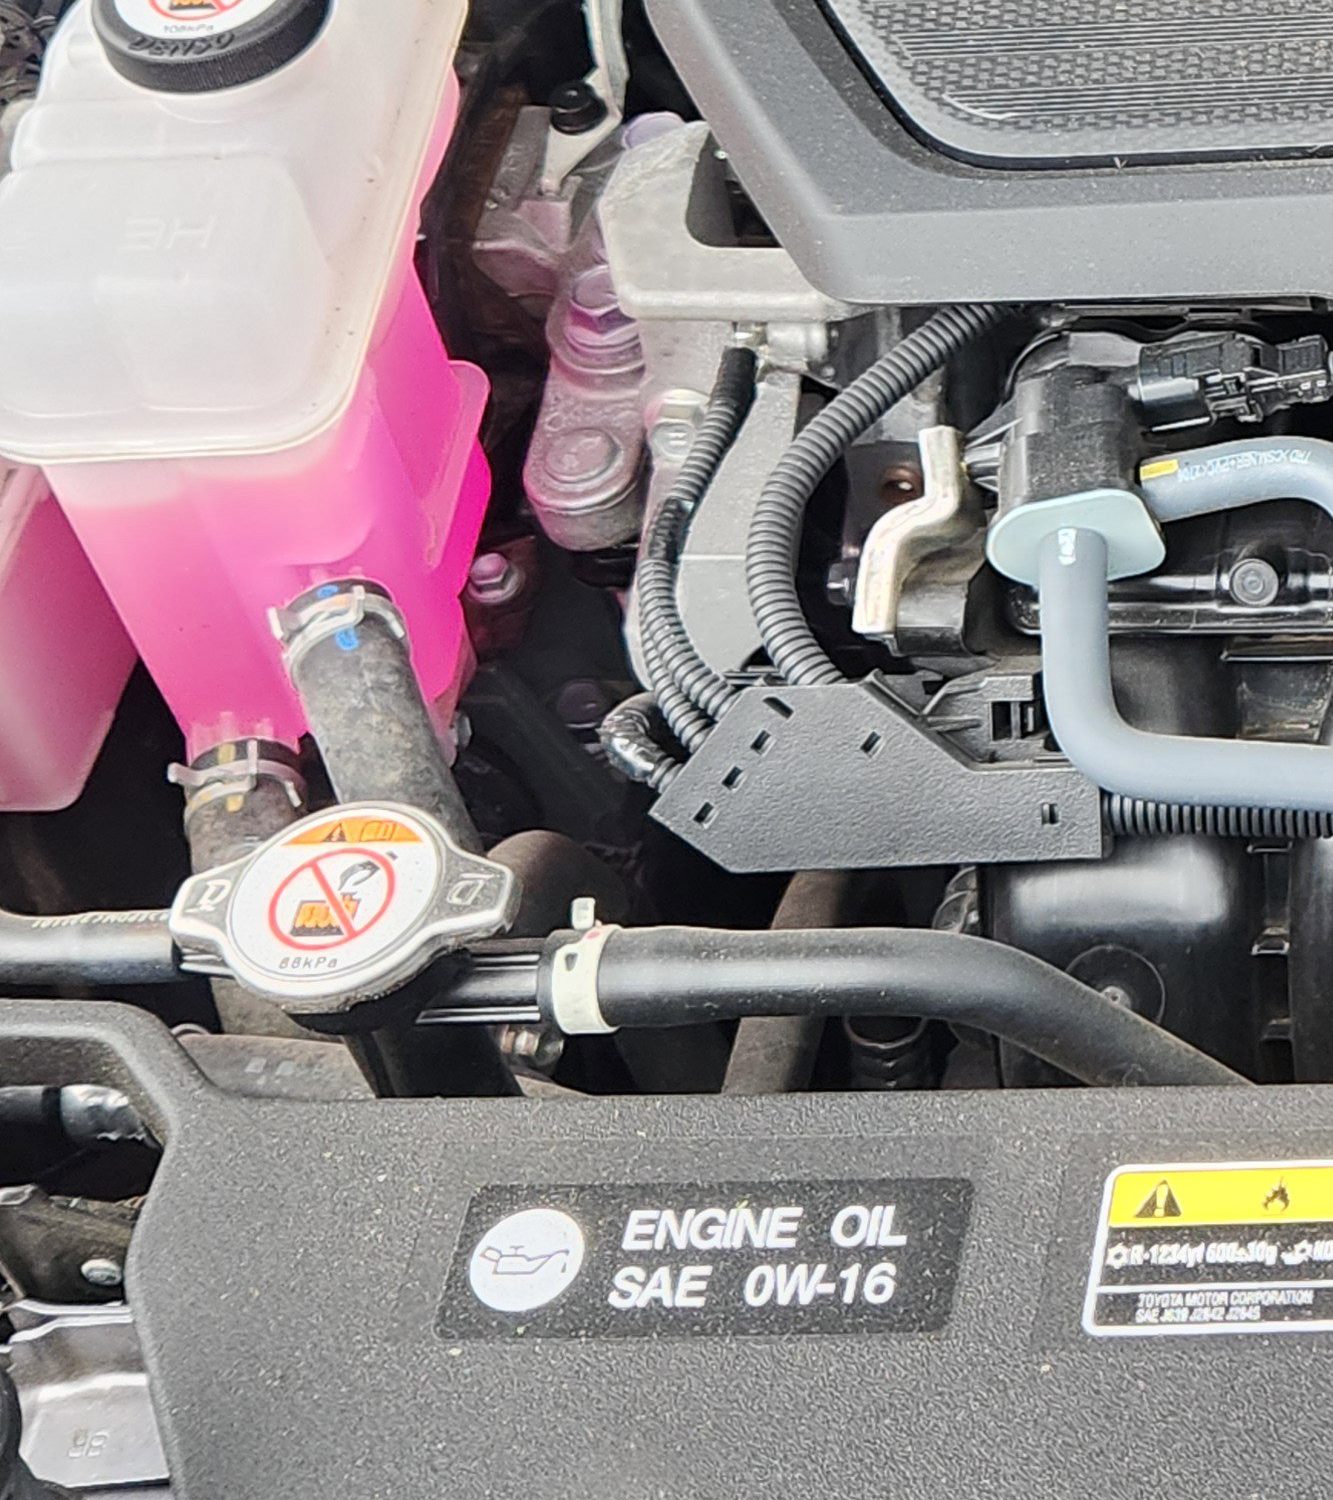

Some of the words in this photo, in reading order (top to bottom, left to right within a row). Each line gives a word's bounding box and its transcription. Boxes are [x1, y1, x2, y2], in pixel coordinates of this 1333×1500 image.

[128, 31, 235, 57] DENSO
[621, 1206, 803, 1251] ENGINE
[830, 1205, 908, 1248] OIL
[607, 1264, 713, 1310] SAE
[744, 1262, 898, 1308] 0W-16
[1137, 1292, 1184, 1308] TOYOTA
[1185, 1291, 1229, 1307] MOTOR
[1230, 1289, 1315, 1306] CORPORATION
[1135, 1308, 1160, 1324] SAE
